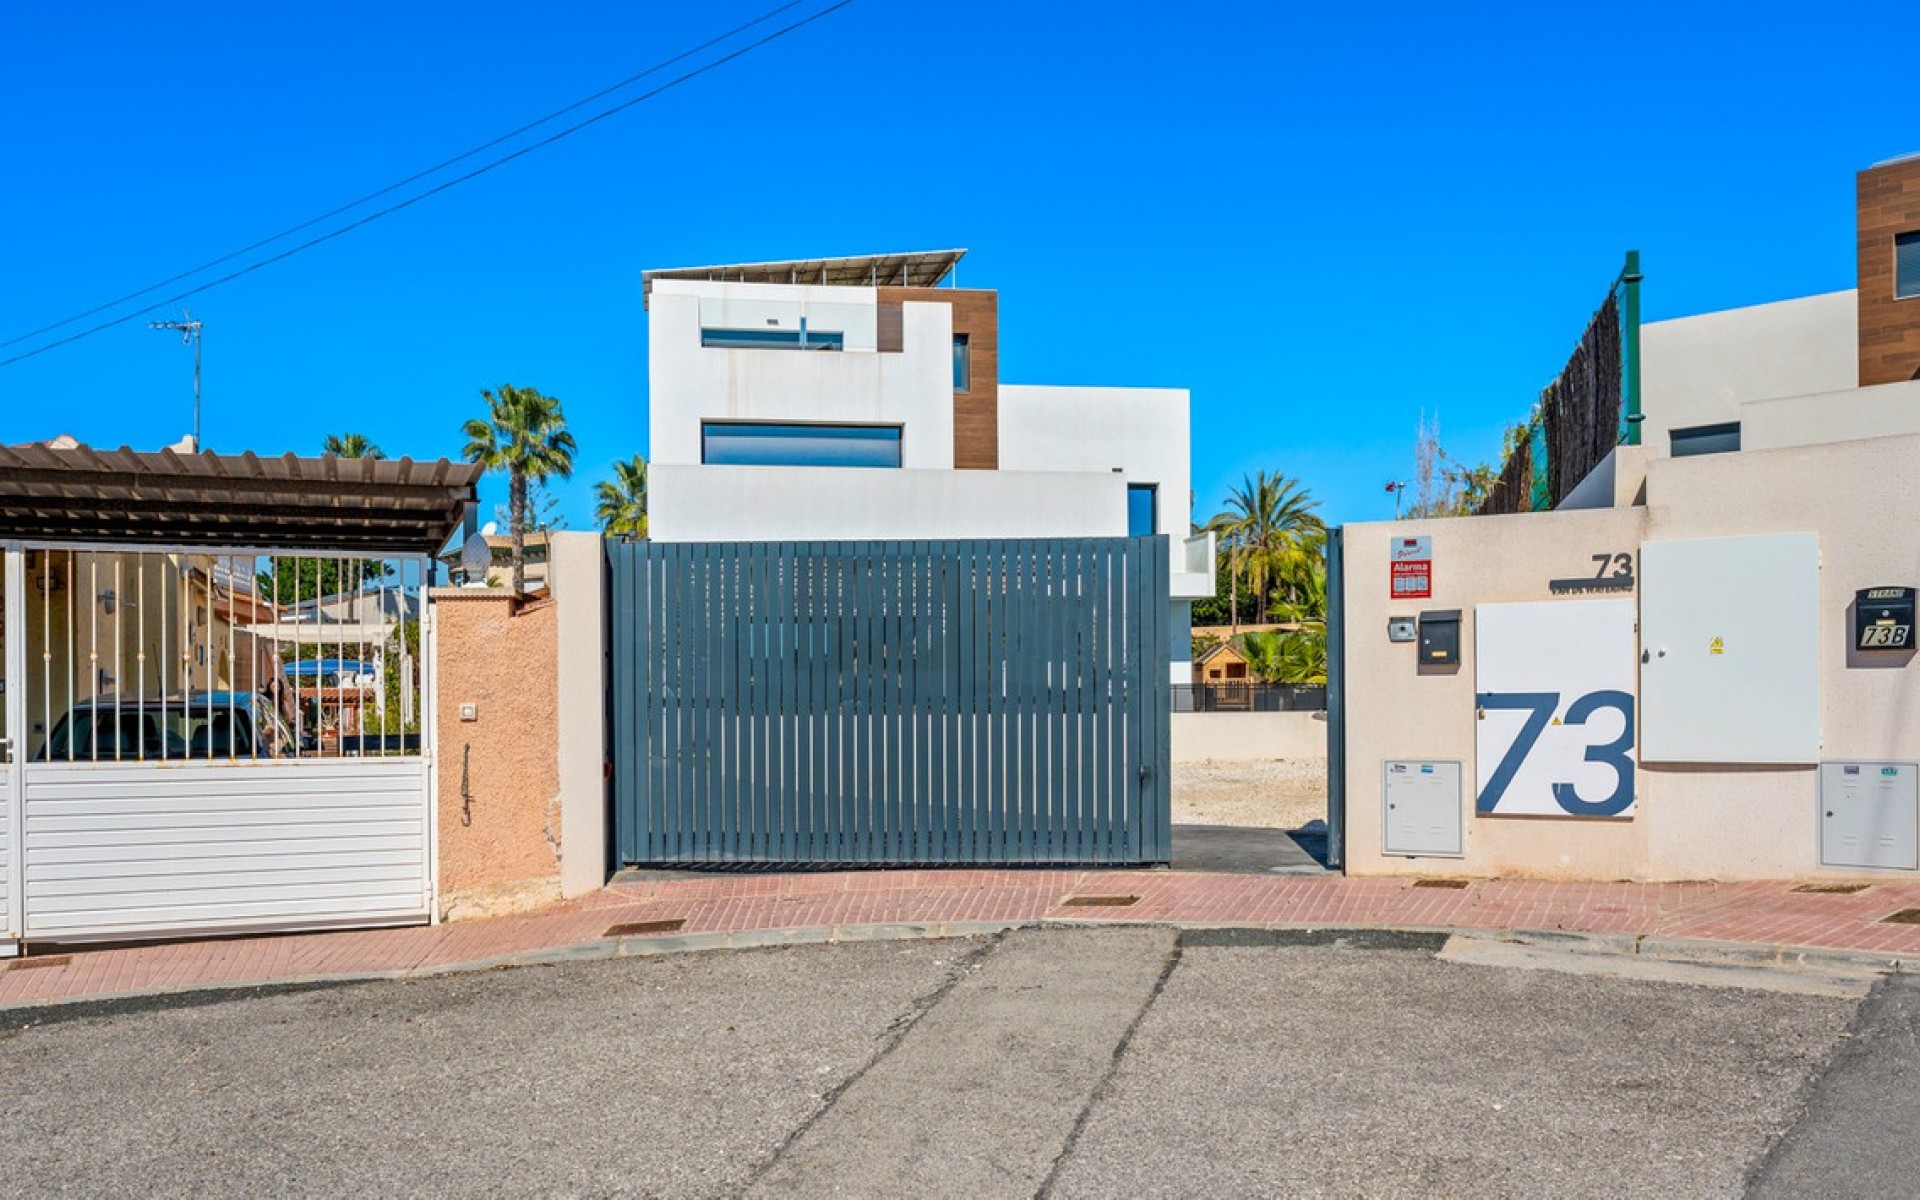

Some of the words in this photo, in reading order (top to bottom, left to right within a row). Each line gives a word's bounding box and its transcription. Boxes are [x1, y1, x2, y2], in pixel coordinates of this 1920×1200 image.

[1394, 563, 1428, 573] Alarma
[1591, 552, 1632, 579] 73
[1864, 626, 1906, 645] 73B
[1476, 689, 1635, 815] 73
